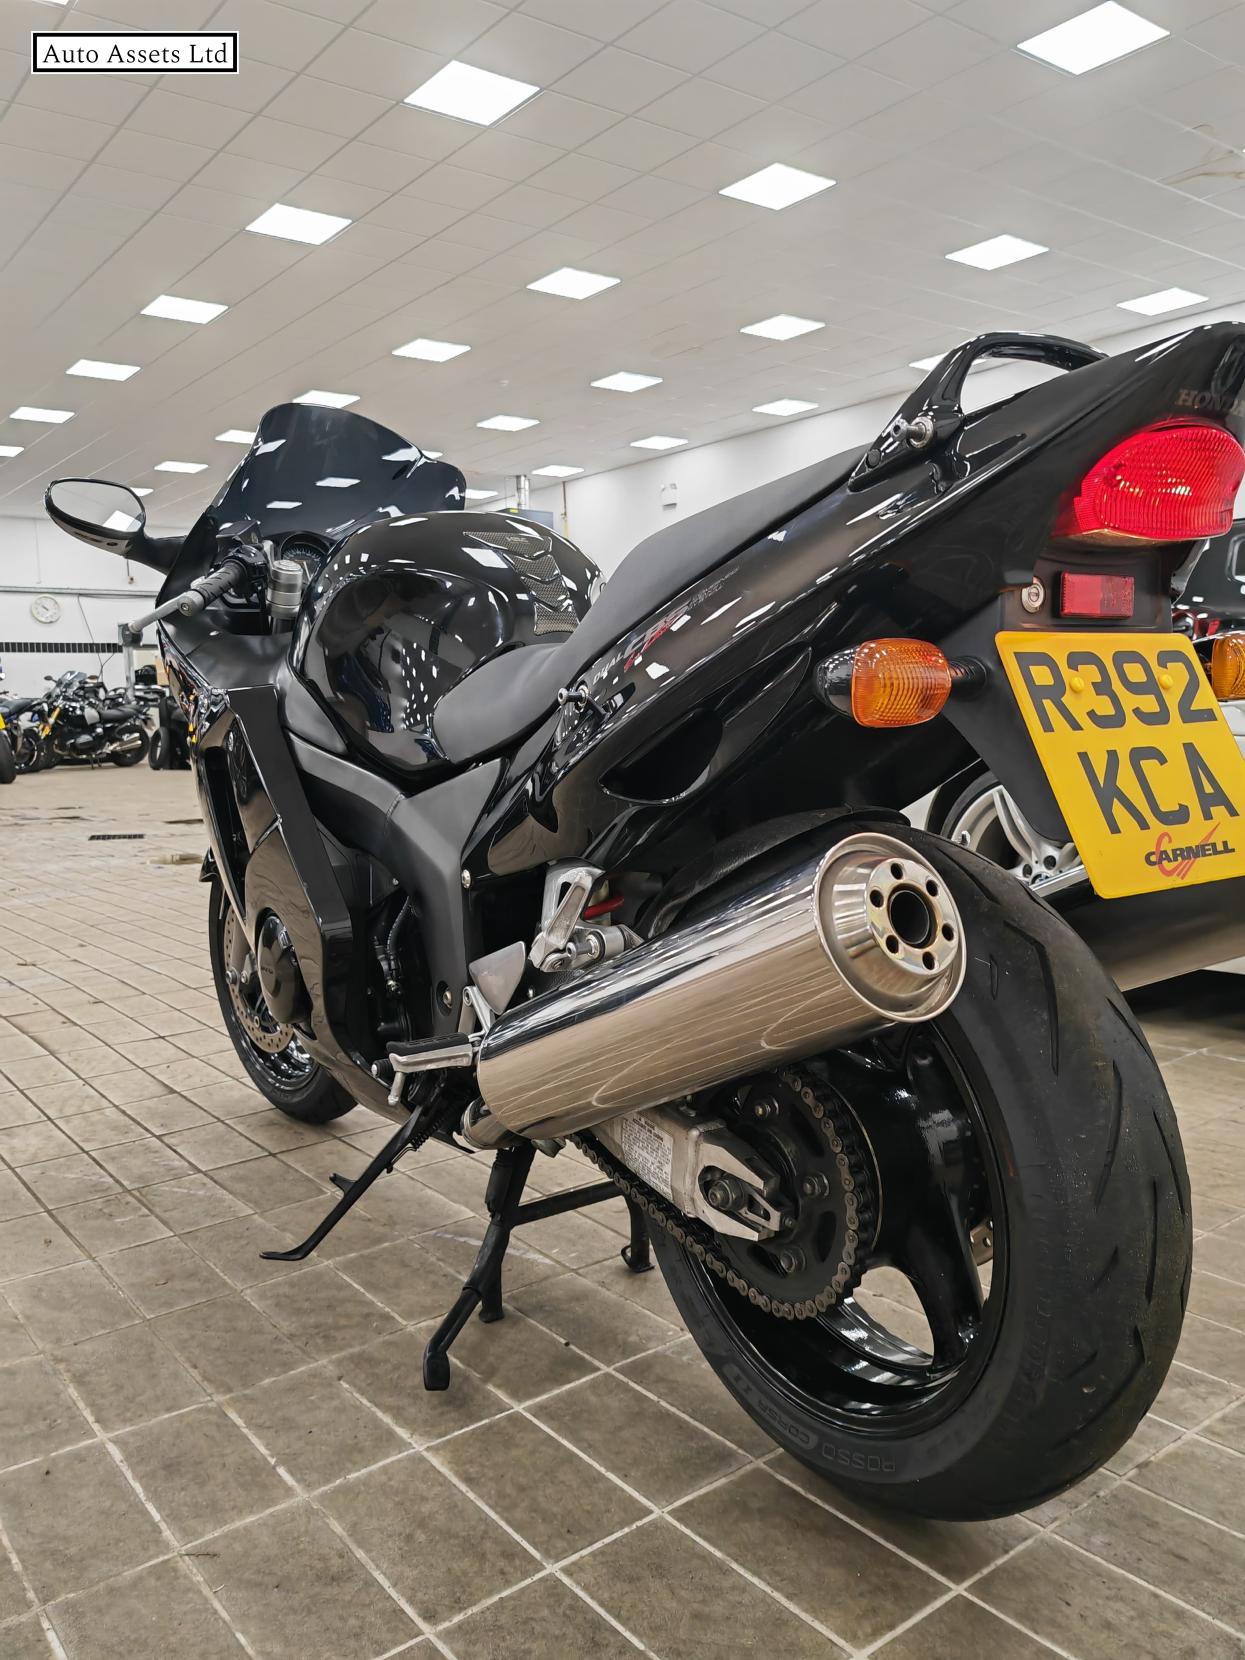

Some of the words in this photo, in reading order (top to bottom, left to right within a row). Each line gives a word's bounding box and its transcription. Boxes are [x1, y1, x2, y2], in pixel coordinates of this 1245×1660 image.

[1013, 650, 1218, 733] R392
[1077, 742, 1240, 835] KCA
[1144, 840, 1236, 867] CARNELL
